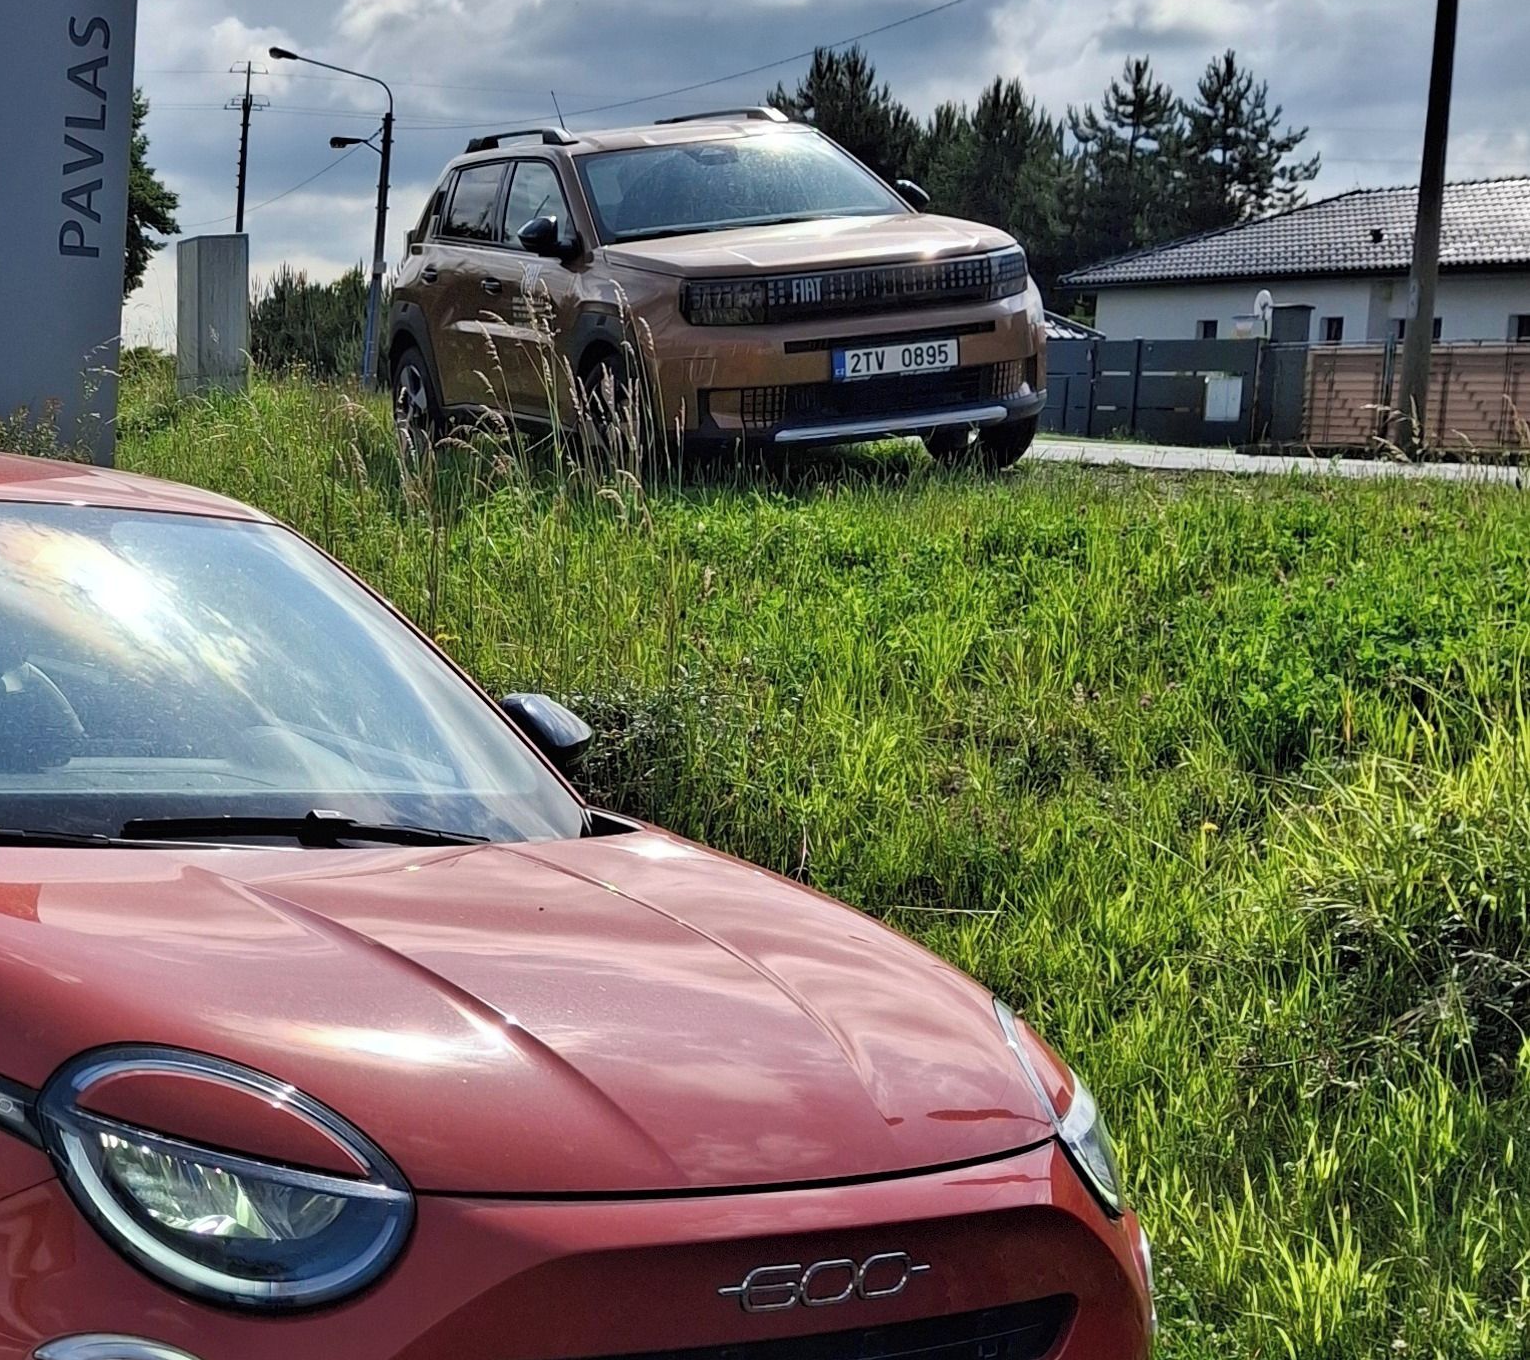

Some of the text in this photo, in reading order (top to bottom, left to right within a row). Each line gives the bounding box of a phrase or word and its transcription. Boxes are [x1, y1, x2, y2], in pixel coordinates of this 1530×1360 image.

[58, 15, 111, 259] PAVLAS
[792, 277, 823, 304] FIAT
[850, 350, 886, 374] 2TV
[901, 343, 949, 368] 0895
